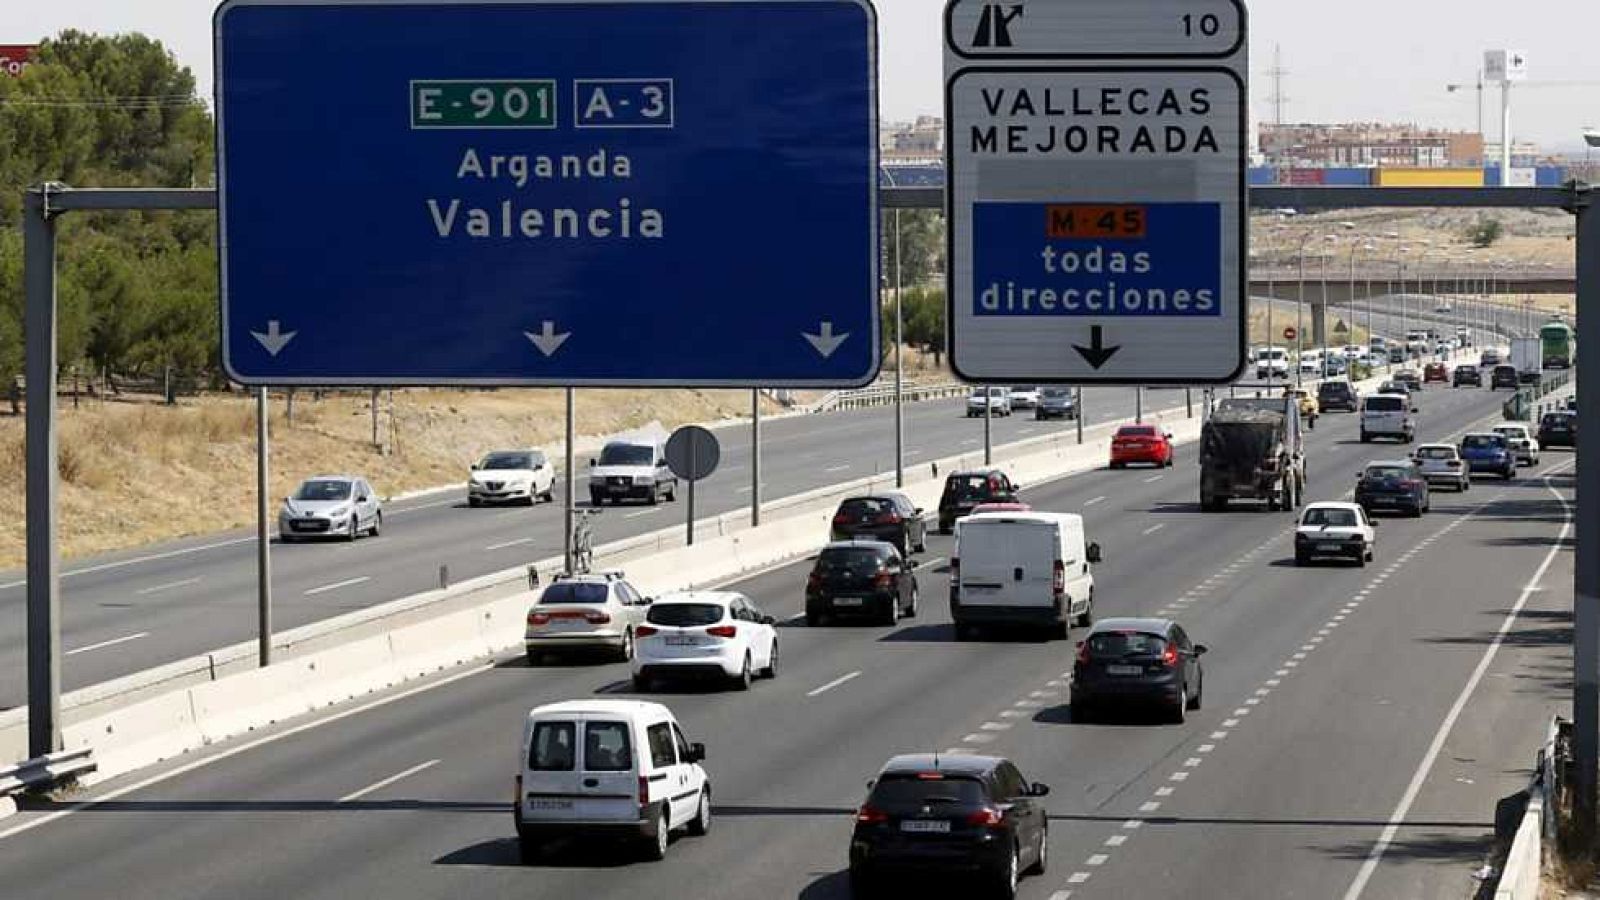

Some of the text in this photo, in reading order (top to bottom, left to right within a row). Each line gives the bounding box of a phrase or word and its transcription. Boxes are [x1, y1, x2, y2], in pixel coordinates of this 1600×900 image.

[1182, 14, 1219, 36] 10
[419, 88, 548, 120] E-901
[584, 86, 665, 119] A-3
[981, 88, 1211, 116] VALLECAS
[970, 126, 1219, 153] MEJORADA
[457, 149, 631, 187] Arganda
[427, 198, 664, 238] Valencia
[1052, 210, 1141, 232] M-45
[1041, 246, 1151, 273] todas
[980, 282, 1214, 311] direcciones
